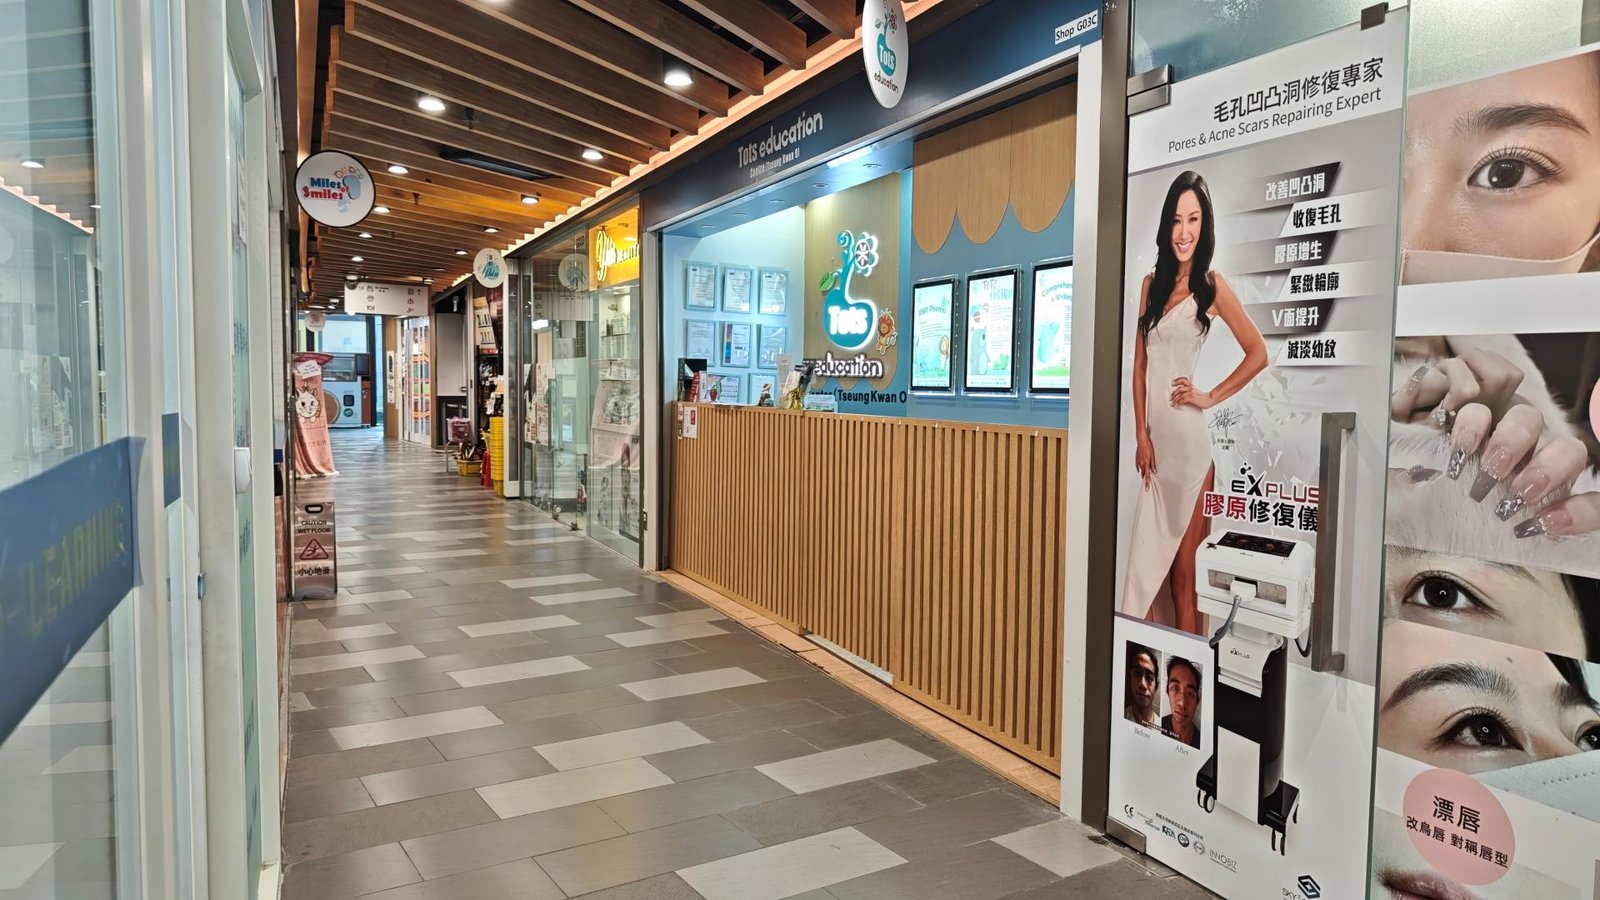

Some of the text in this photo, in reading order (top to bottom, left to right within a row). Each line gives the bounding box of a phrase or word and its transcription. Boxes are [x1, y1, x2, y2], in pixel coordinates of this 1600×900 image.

[1056, 14, 1097, 41] Shop G03C
[878, 44, 895, 70] Tots
[874, 71, 899, 94] education
[1213, 57, 1384, 124] 毛孔凹凸洞修復專家
[1168, 87, 1382, 153] Pores & Acne Scars Repairing Expert
[738, 110, 823, 168] Tots education
[303, 186, 344, 200] Smiles
[310, 177, 341, 189] Miles
[1265, 172, 1325, 201] 改善凹凸洞
[1292, 203, 1342, 229] 收復毛孔
[1274, 240, 1323, 264] 膠原增生
[1290, 271, 1340, 294] 緊緻輪廓
[828, 305, 868, 335] Tots
[1272, 306, 1320, 328] V面提升
[814, 350, 884, 378] education
[870, 390, 897, 404] Kwan
[1204, 493, 1318, 532] 膠原修復儀
[298, 566, 330, 577] 小心地滑
[1432, 795, 1481, 834] 漂唇
[1450, 833, 1509, 869] 對稱唇型
